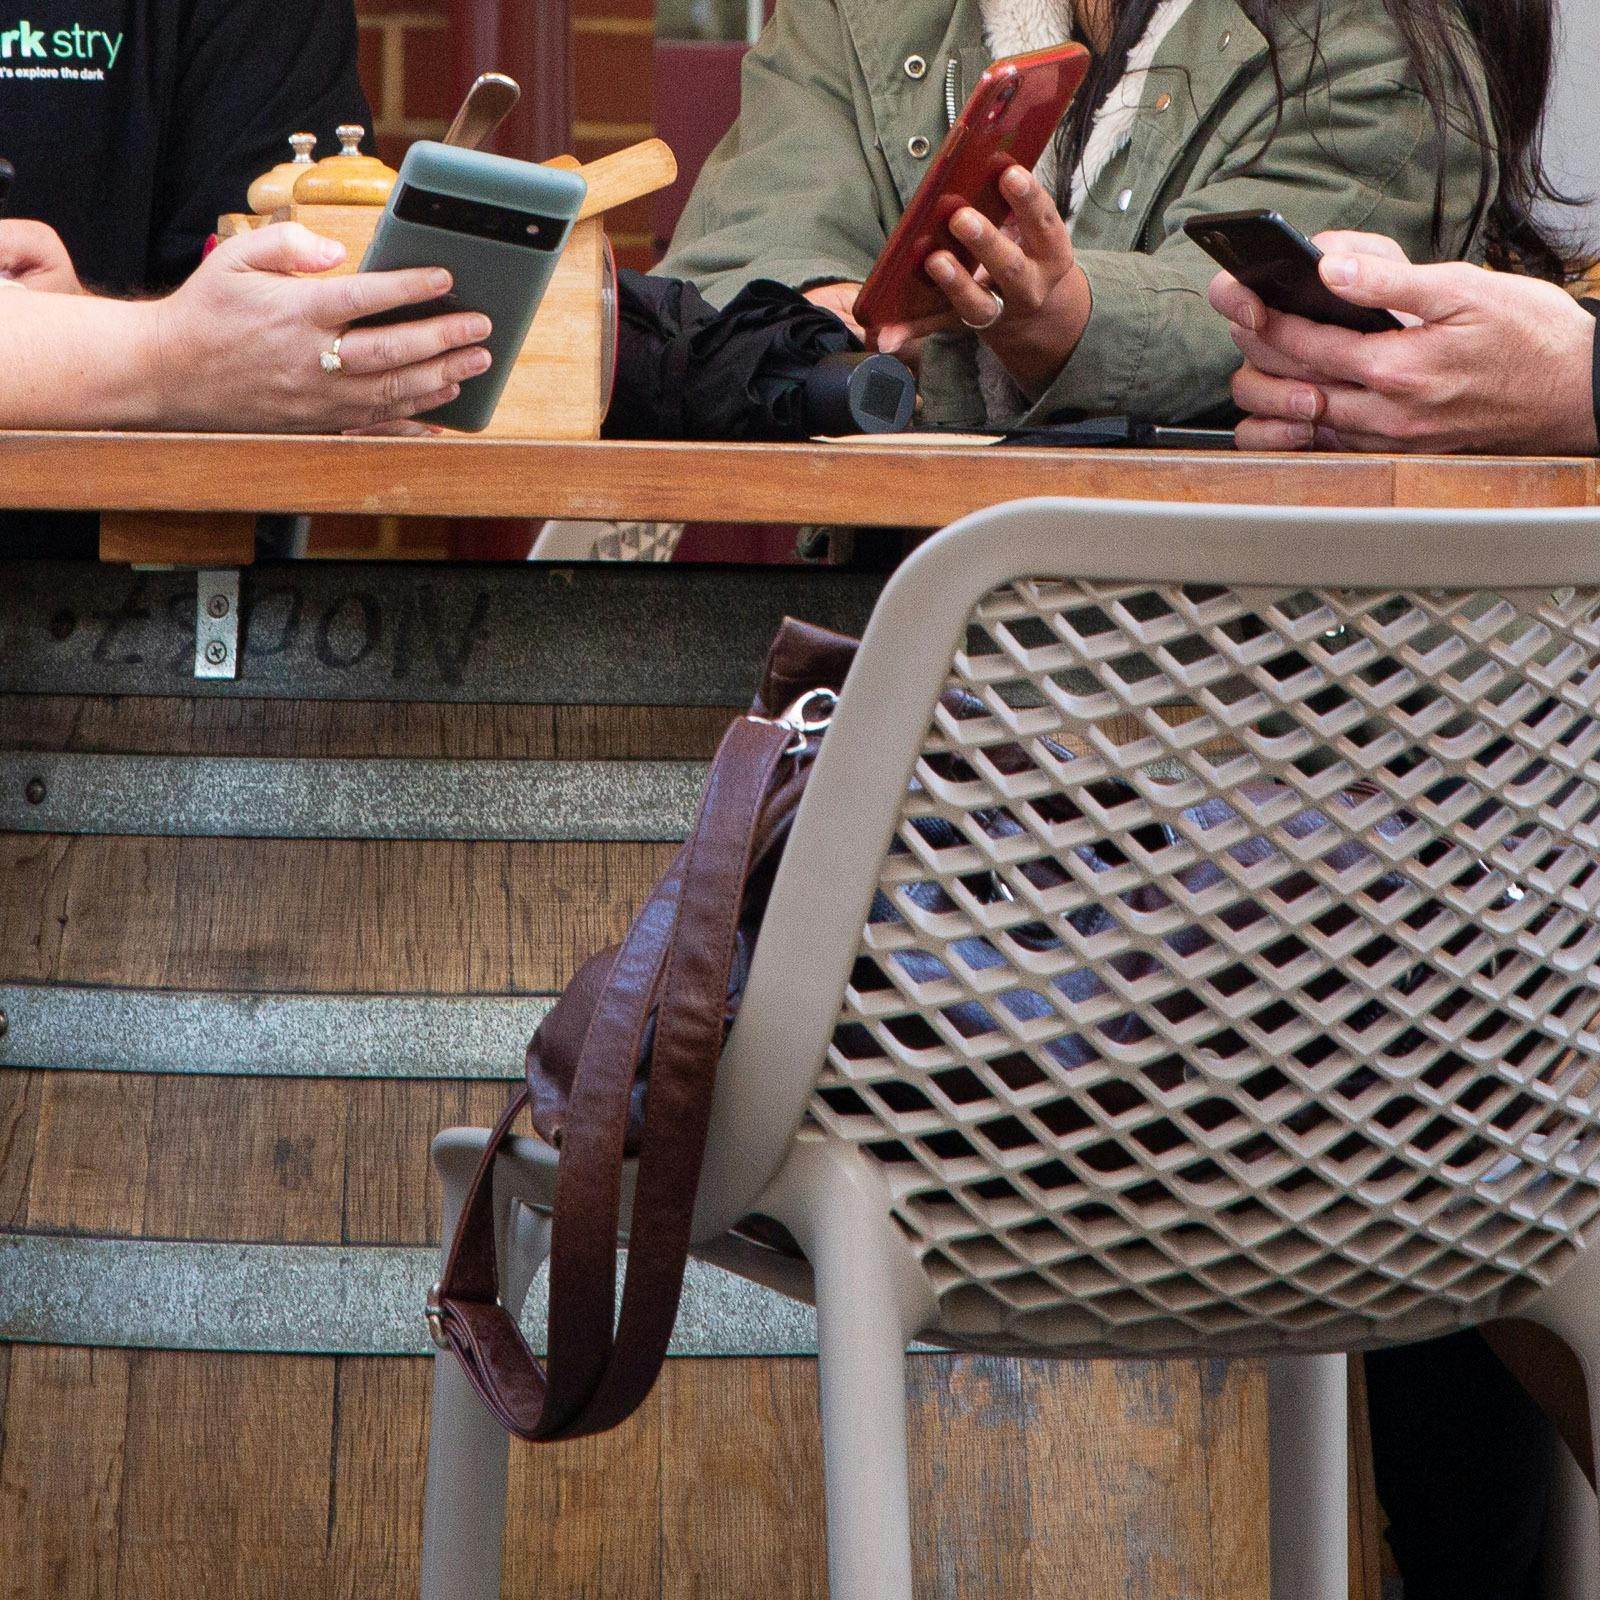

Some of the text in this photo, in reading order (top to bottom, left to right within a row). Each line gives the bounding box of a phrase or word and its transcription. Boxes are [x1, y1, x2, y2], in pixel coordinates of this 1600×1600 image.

[52, 22, 123, 69] stry
[15, 66, 59, 81] explore
[60, 66, 79, 79] the
[80, 67, 104, 81] dark
